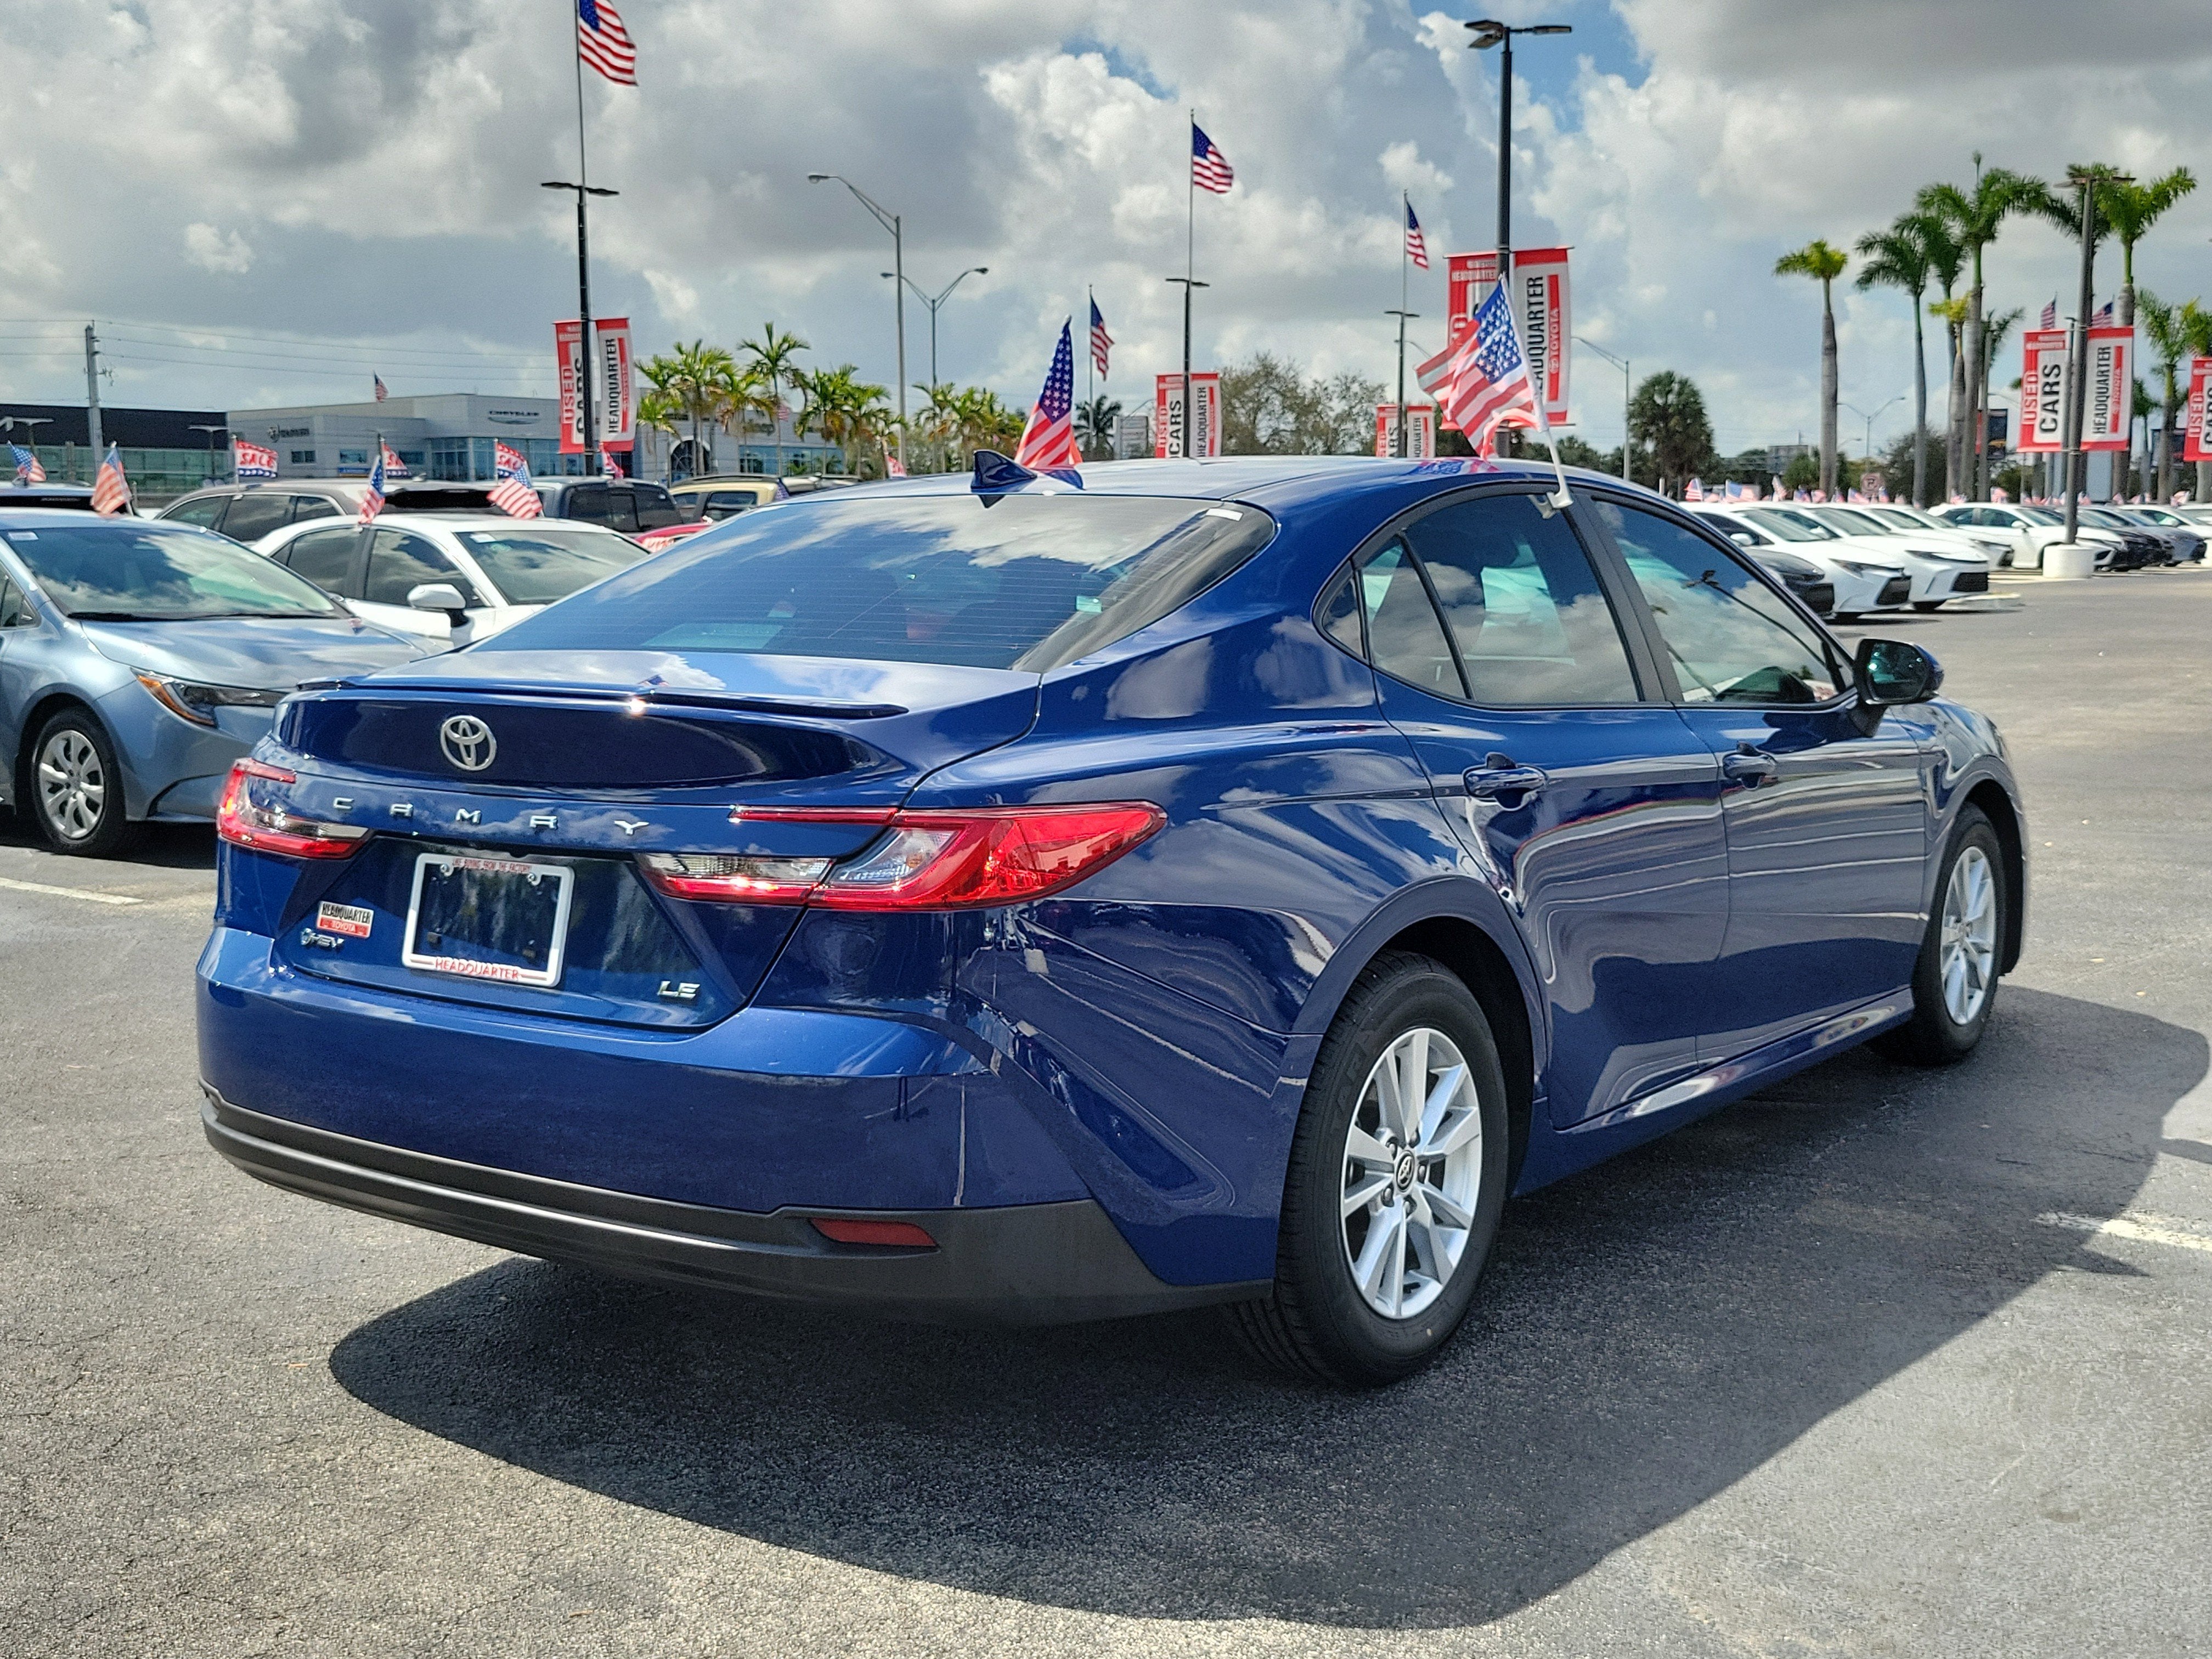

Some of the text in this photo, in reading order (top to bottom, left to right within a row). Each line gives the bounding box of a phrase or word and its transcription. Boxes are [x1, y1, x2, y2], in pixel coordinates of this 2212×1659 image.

[1526, 276, 1547, 394] ADQUARTER
[1549, 307, 1560, 357] TOYOTA
[563, 368, 574, 422] USED
[605, 338, 620, 433] HEADQUARTER
[2024, 371, 2038, 421] USED
[2039, 364, 2061, 432] CARS
[2093, 346, 2112, 434] HEADQUARTER
[1159, 408, 1167, 445] USED
[1169, 400, 1182, 455] CARS
[1197, 387, 1207, 454] HEADQUARTER
[2188, 393, 2203, 436] USED
[333, 797, 650, 836] CAMRY
[321, 902, 372, 924] HEADQUARTER
[331, 920, 357, 932] TOYOTA
[435, 958, 519, 980] HEADQUARTER
[657, 980, 700, 999] LE
